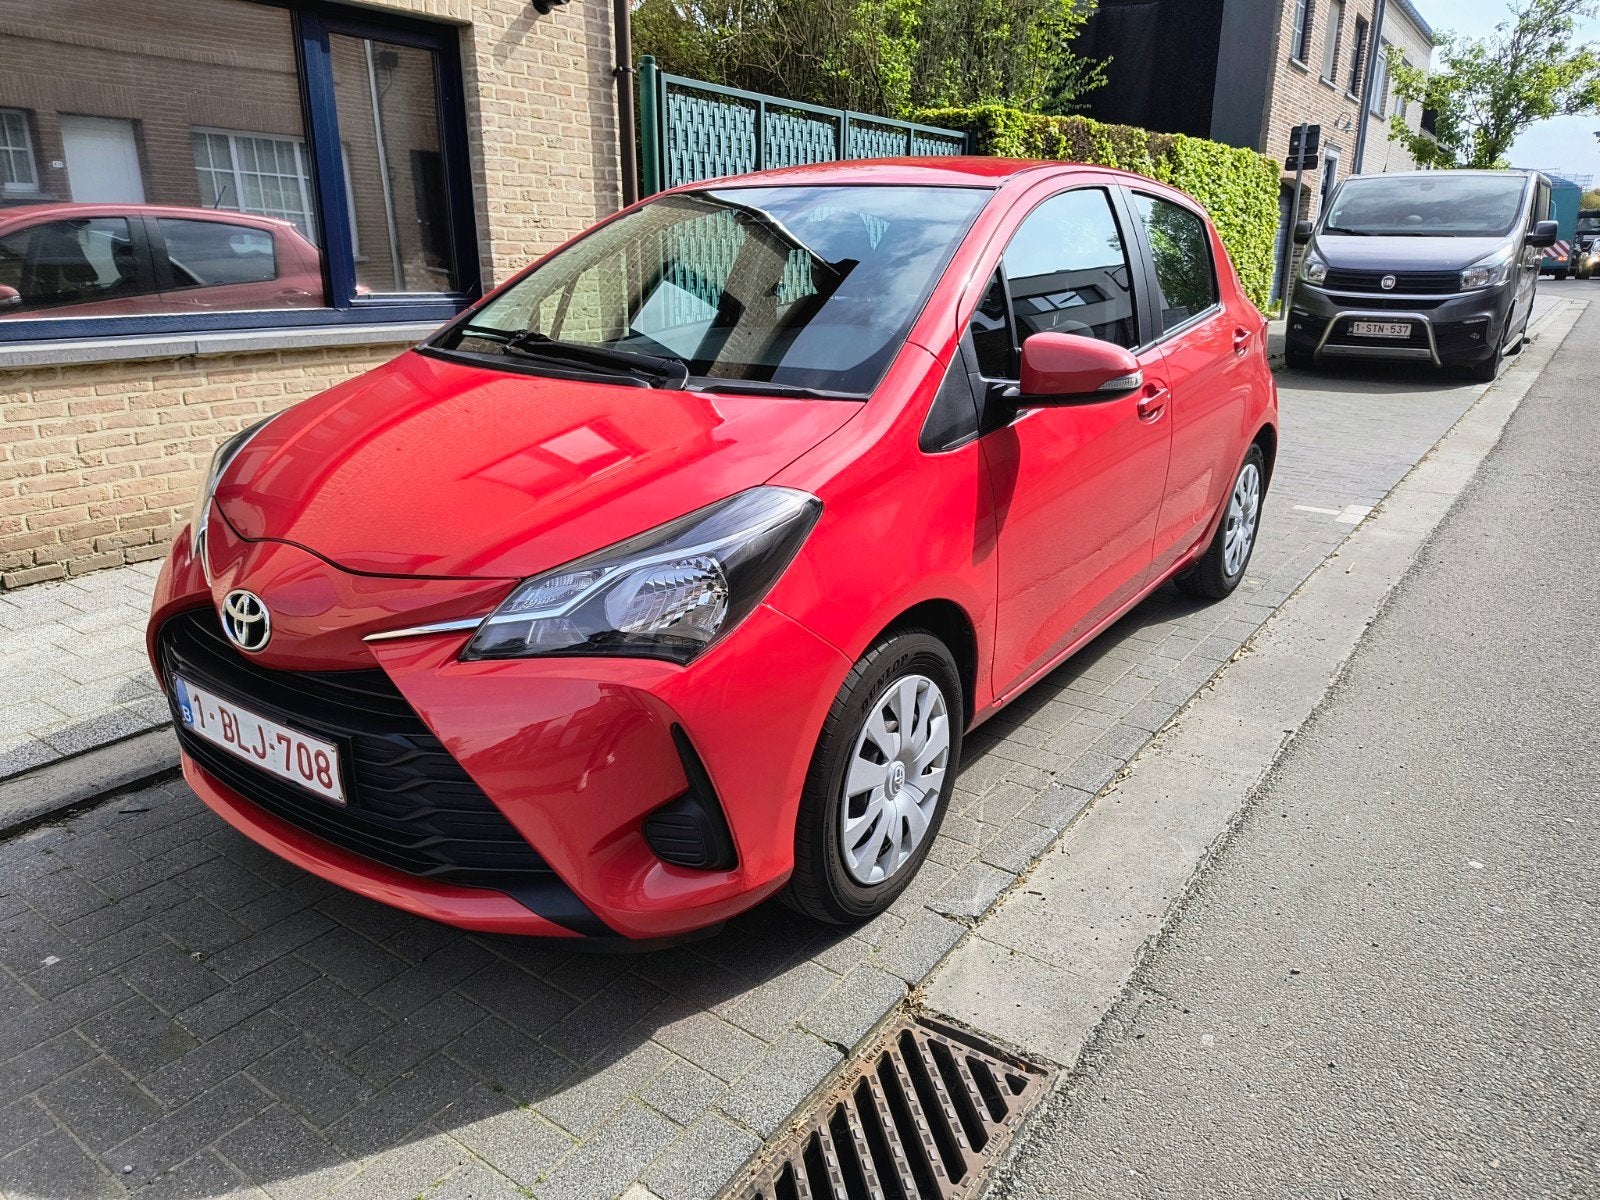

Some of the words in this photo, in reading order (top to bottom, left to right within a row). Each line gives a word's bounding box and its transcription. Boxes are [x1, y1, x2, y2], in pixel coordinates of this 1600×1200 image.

[861, 653, 909, 711] DUNLOP
[182, 704, 192, 723] B
[193, 694, 333, 789] 1-BLJ-708
